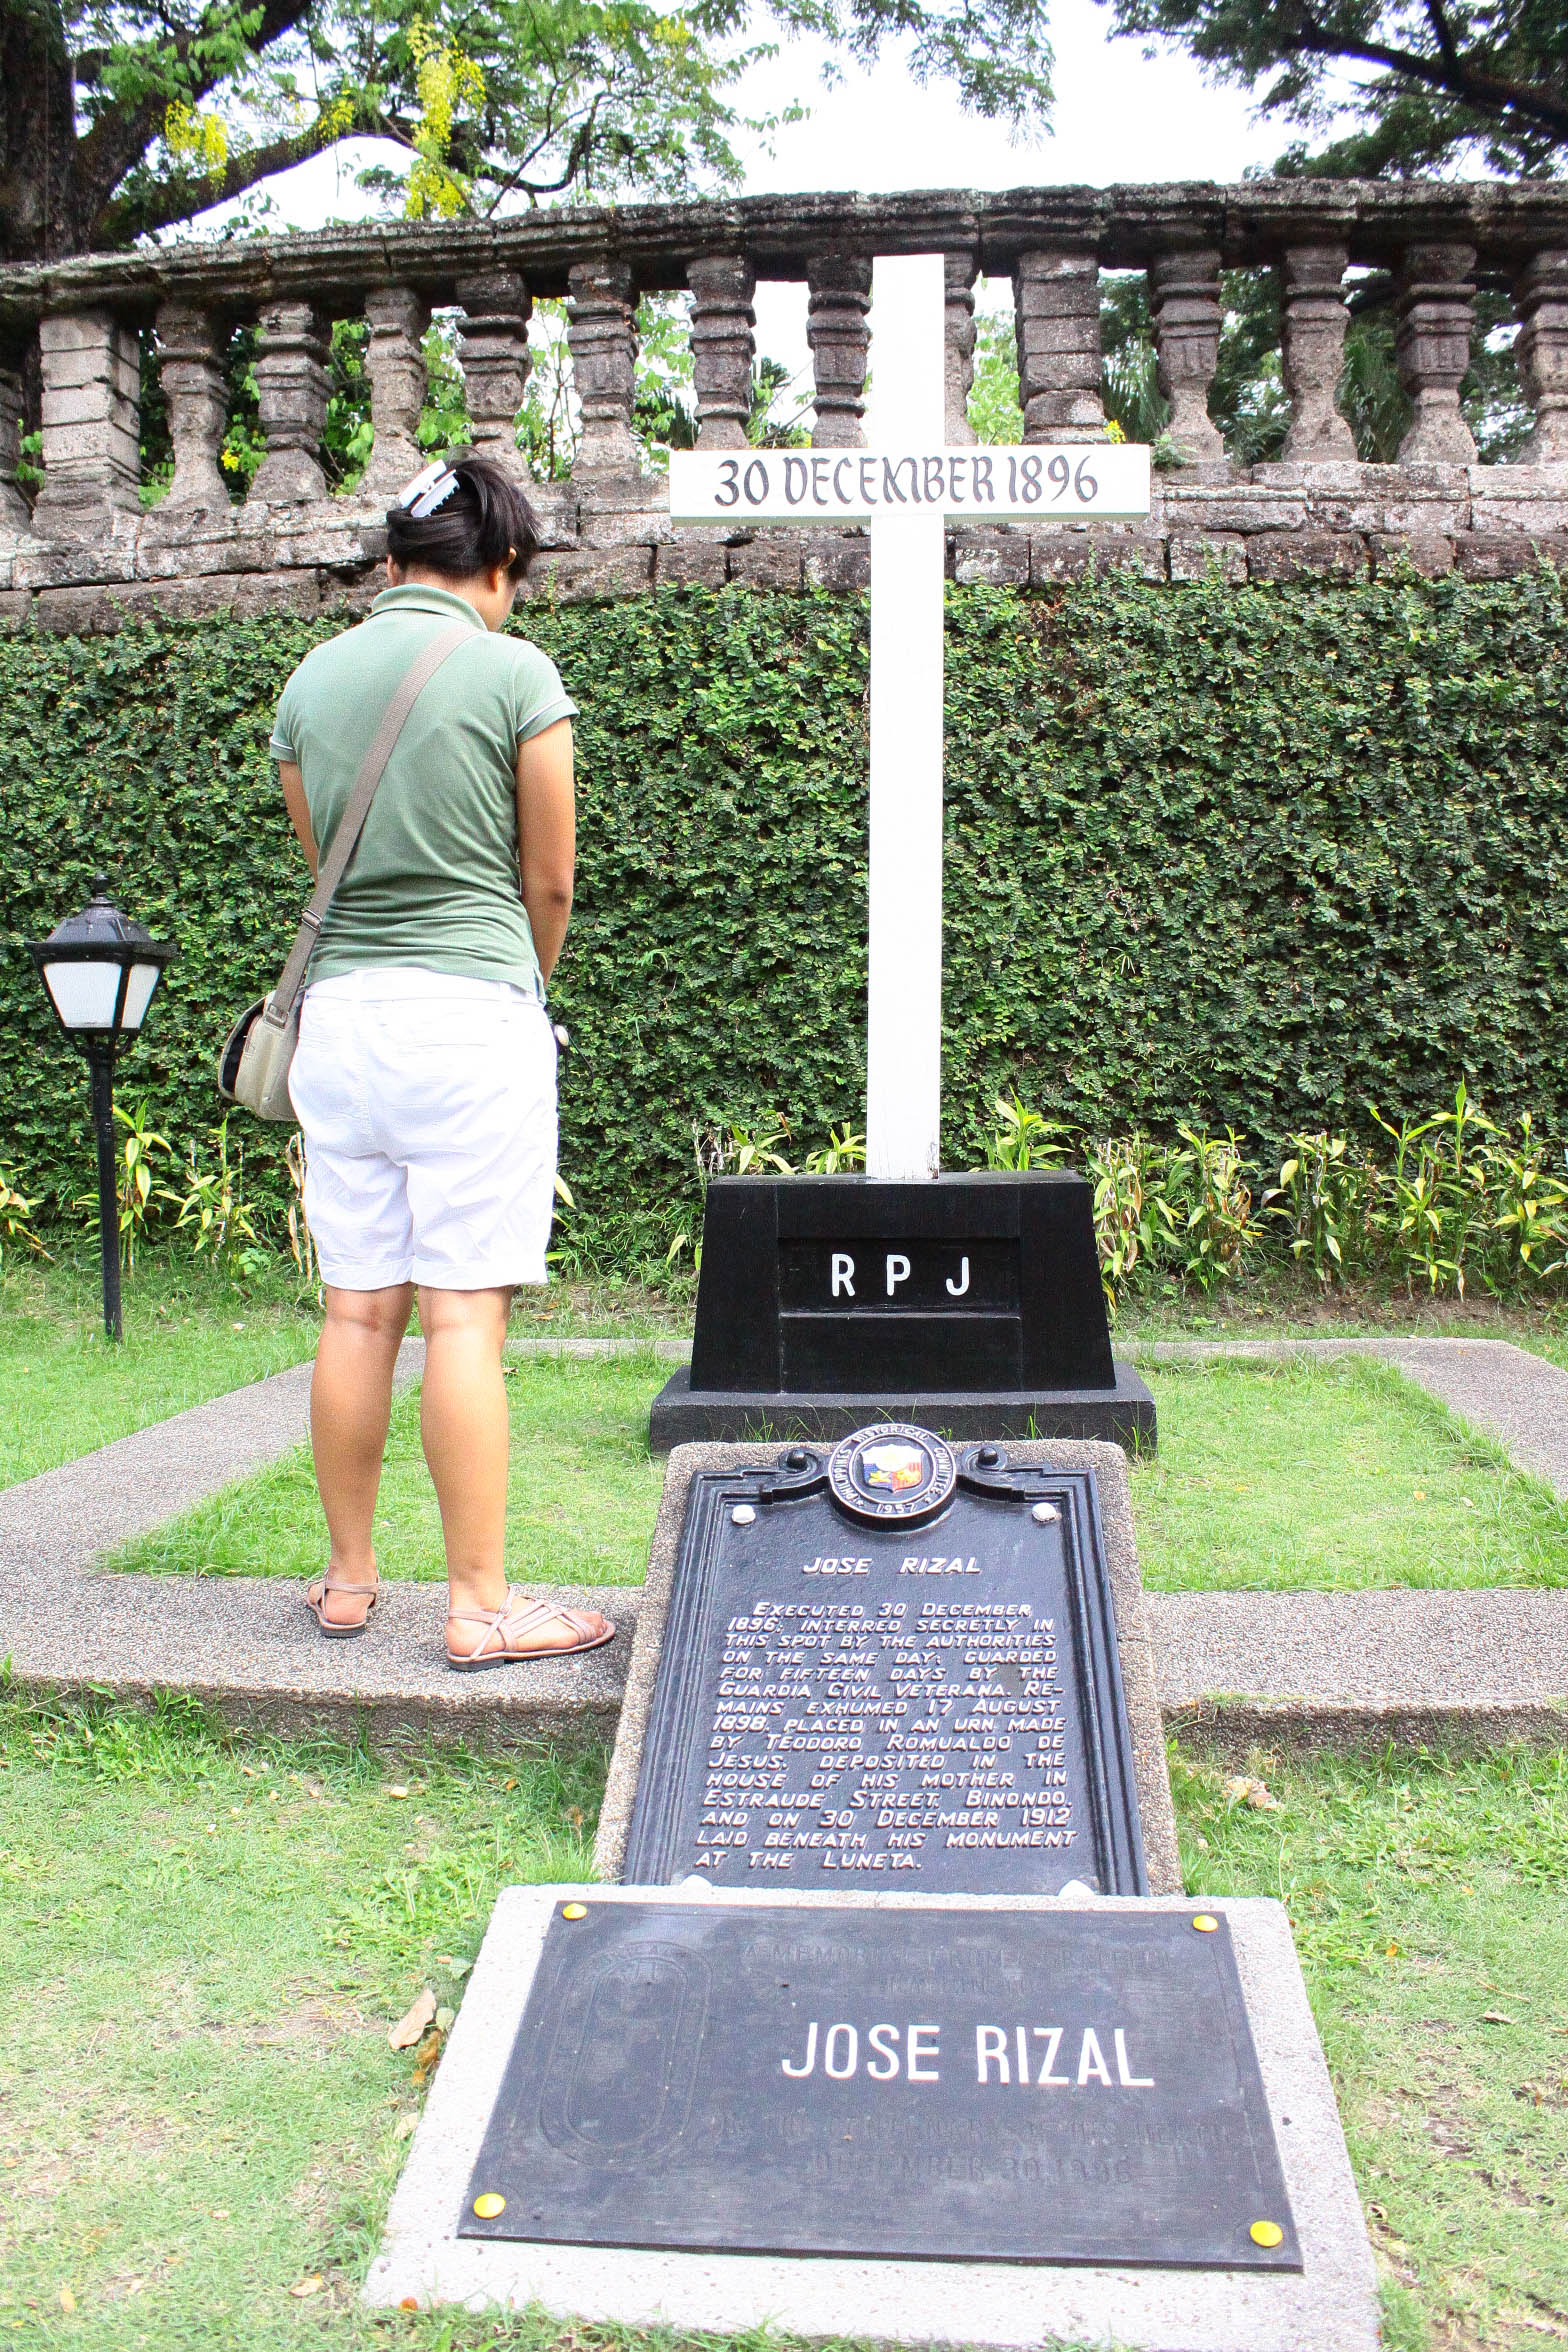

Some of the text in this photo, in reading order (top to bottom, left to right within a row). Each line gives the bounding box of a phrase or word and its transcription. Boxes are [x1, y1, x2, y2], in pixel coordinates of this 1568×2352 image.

[714, 455, 1098, 507] 30 DECEMBER 1896
[832, 1254, 969, 1297] R P J
[855, 1425, 929, 1442] HISTORICAL
[803, 1556, 981, 1576] JOSE RIZAL
[752, 1601, 1033, 1621] EXECUTED 30 DECEMBER
[800, 1619, 901, 1634] INTERRED
[916, 1618, 1022, 1631] SECRETLY
[1033, 1618, 1055, 1633] IN
[726, 1633, 1056, 1650] THIS SPOT BY THE AUTHORITIES
[722, 1650, 752, 1663] ON
[765, 1651, 805, 1666] THE
[820, 1652, 879, 1665] SAME
[964, 1650, 1057, 1663] GUARDED
[720, 1666, 1058, 1685] FOR FIFTEEN DAYS BY THE
[719, 1681, 811, 1697] GUARDIA
[827, 1681, 884, 1701] CIVIL
[716, 1698, 1061, 1718] MAINS EXHUMED 17 AUGUST
[783, 1718, 865, 1735] PLACED
[879, 1718, 902, 1736] IN
[910, 1718, 940, 1731] AN
[954, 1717, 998, 1734] URN
[1007, 1716, 1066, 1733] MADE
[710, 1731, 1065, 1753] BY TEODORO ROMUALDO DE
[819, 1754, 948, 1772] DEPOSITED
[972, 1754, 996, 1771] IN
[1025, 1752, 1065, 1768] THE
[706, 1770, 1069, 1792] HOUSE OF HIS MOTHER IN
[703, 1789, 831, 1812] ESTRAUDE
[701, 1807, 1071, 1830] AND ON 30 DECEMBER 1912
[696, 1829, 1077, 1851] LAID BENEATH HIS MONUMENT
[695, 1850, 727, 1866] AT
[749, 1851, 796, 1867] THE
[781, 2022, 1155, 2088] JOSE RIZAL
